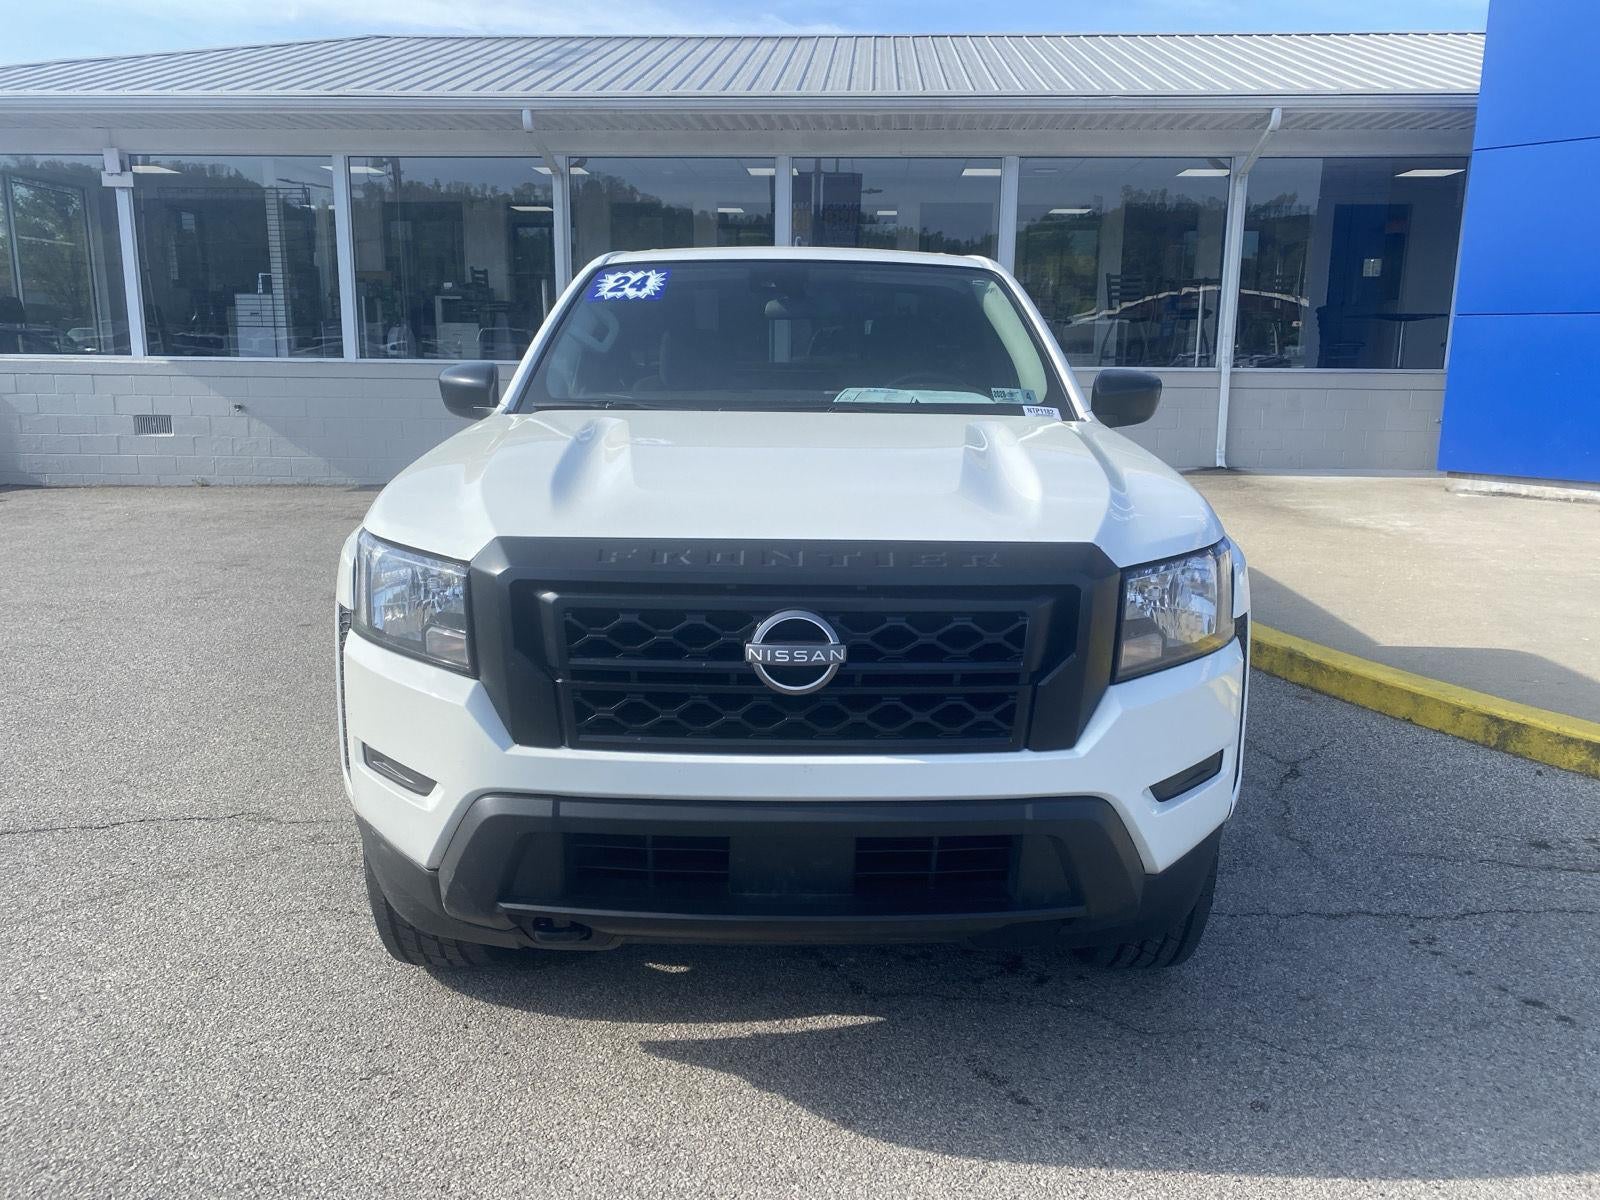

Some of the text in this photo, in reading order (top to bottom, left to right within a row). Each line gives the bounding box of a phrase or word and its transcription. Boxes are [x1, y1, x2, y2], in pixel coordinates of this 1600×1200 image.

[606, 275, 651, 293] 24
[596, 548, 1003, 568] FRONTIER
[748, 648, 844, 662] NISSAN
